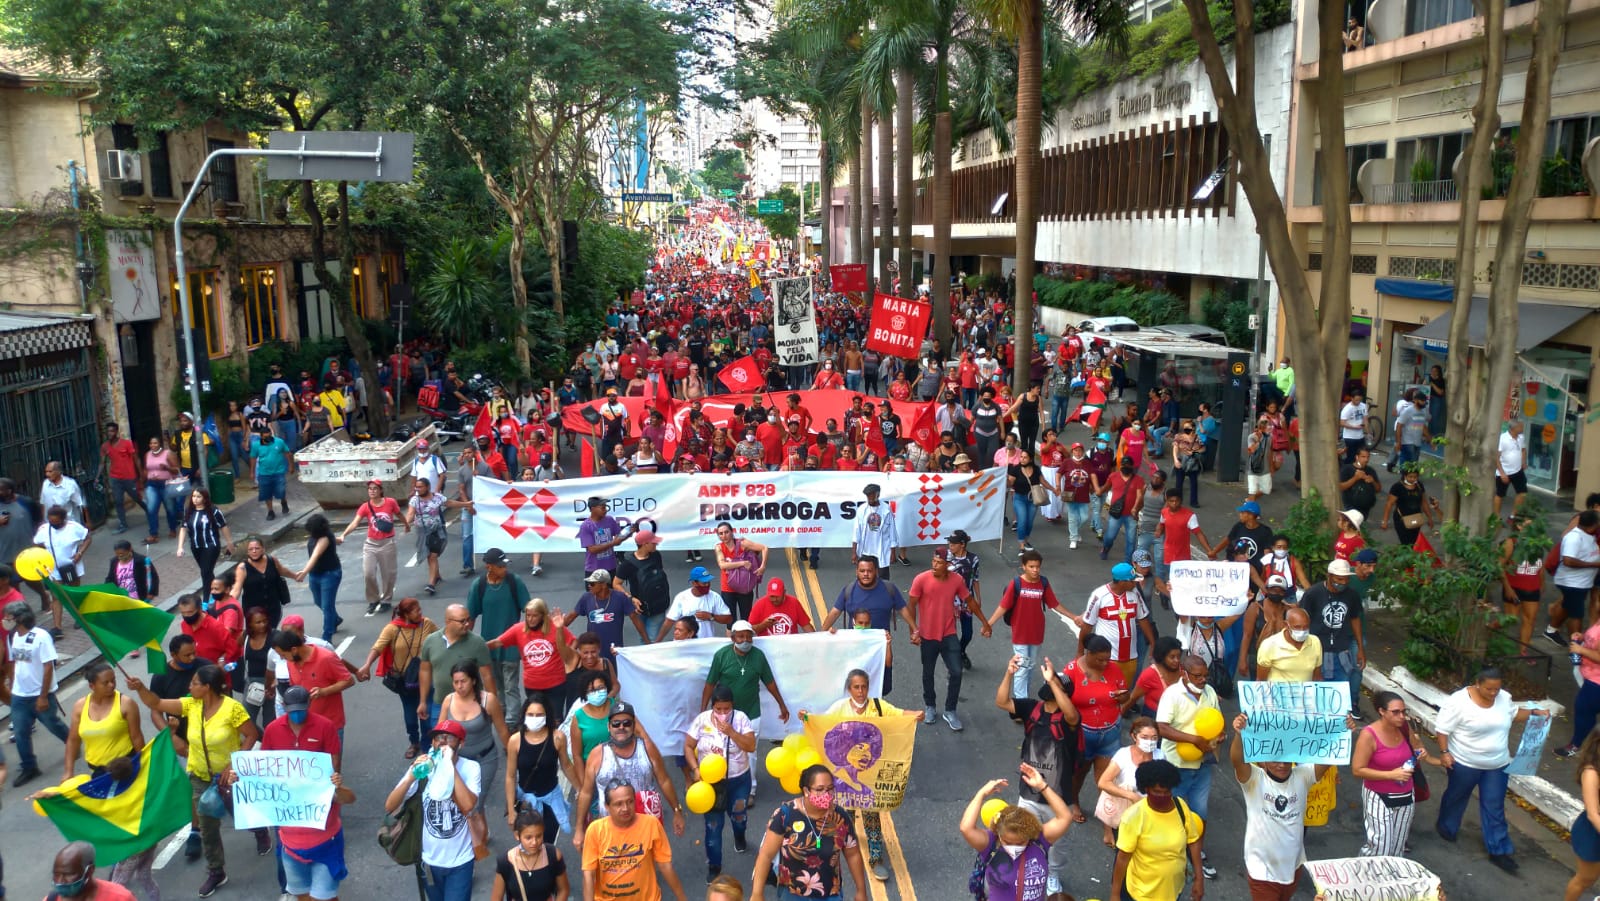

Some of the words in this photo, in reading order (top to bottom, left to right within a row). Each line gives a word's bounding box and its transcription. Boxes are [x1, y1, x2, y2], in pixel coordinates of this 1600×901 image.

[882, 297, 920, 317] MARIA
[777, 336, 814, 347] MORADIA
[873, 328, 914, 348] BONITA
[782, 353, 813, 364] VIDA
[786, 346, 805, 355] PELA
[698, 484, 740, 498] ADPF
[745, 484, 776, 497] 828
[573, 497, 657, 513] DSPEJO
[699, 501, 832, 522] PRORROGA
[739, 527, 749, 535] NO
[750, 526, 776, 534] CAMPO
[784, 526, 795, 534] NA
[797, 525, 823, 534] CIDADE
[1243, 684, 1255, 706] O
[1256, 680, 1343, 715] PREFEITO
[1303, 713, 1348, 735] NEVES
[236, 756, 324, 781] QUEREMOS
[235, 780, 291, 805] NOSSOS
[274, 801, 328, 823] DIREITOS
